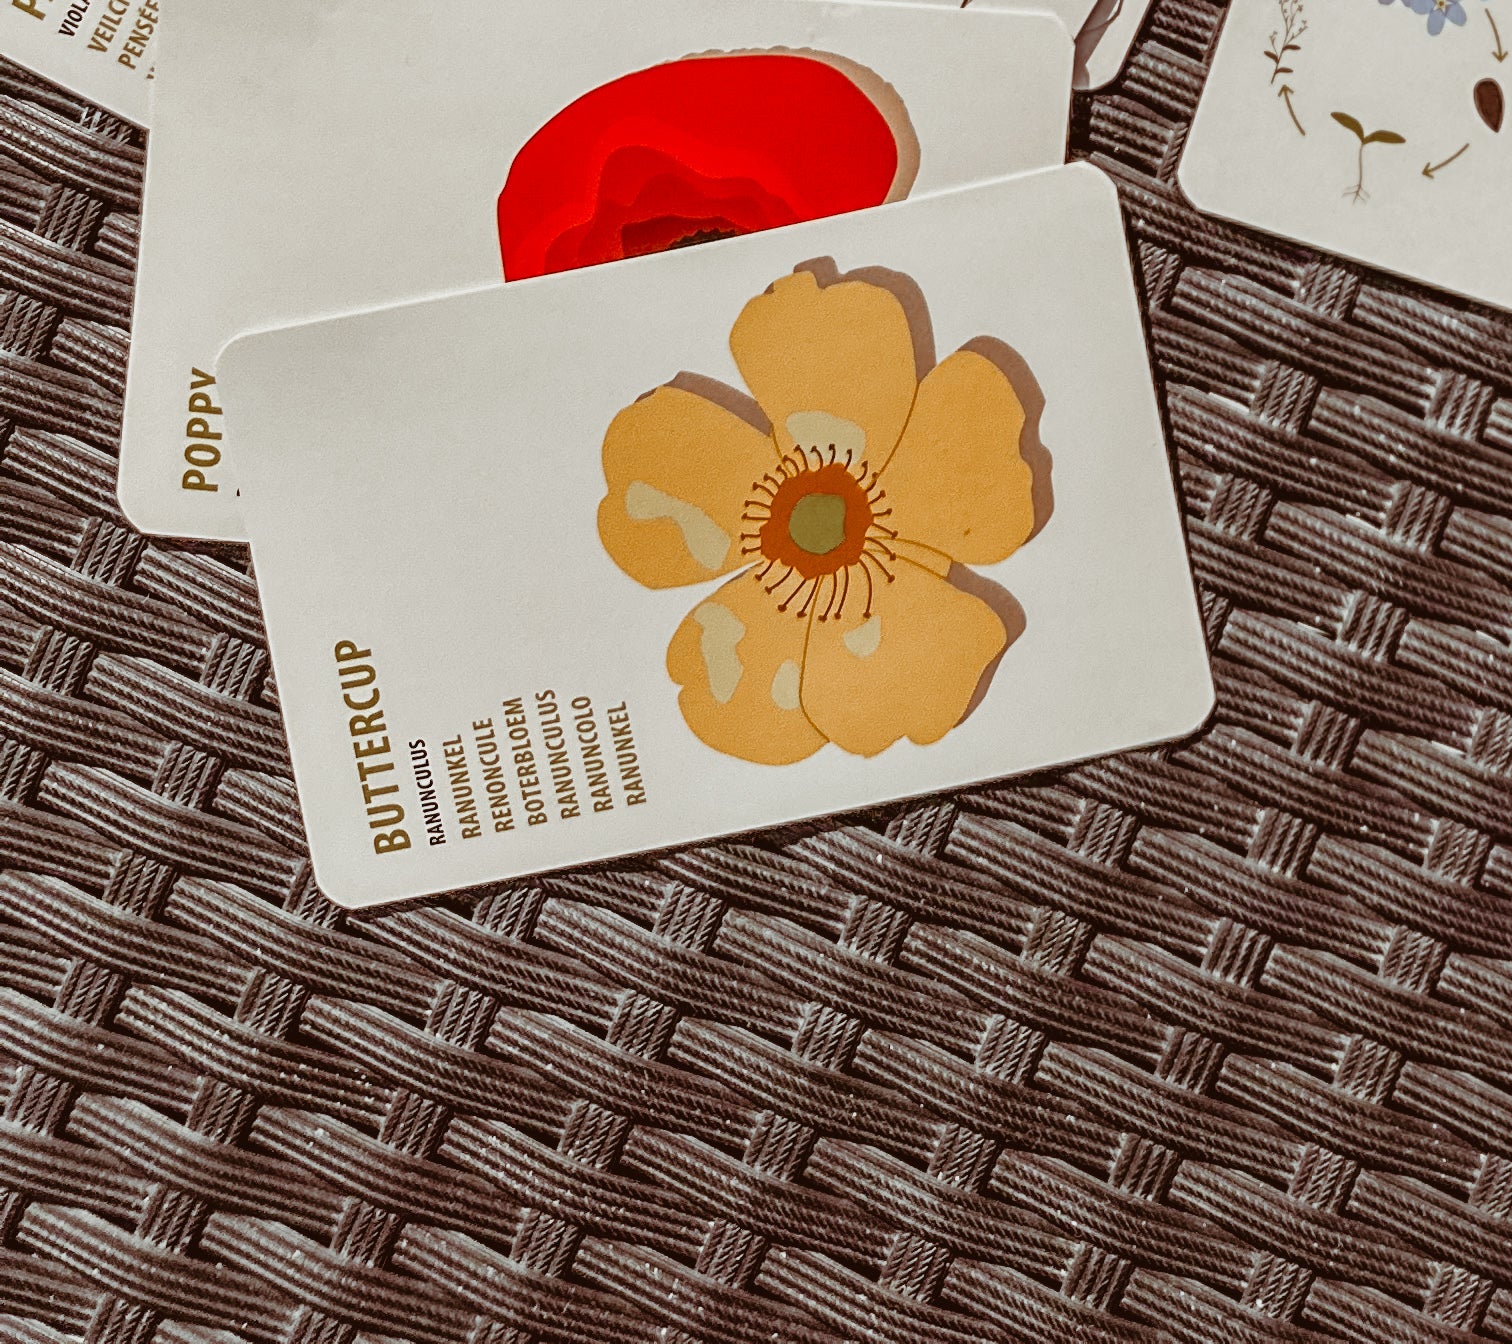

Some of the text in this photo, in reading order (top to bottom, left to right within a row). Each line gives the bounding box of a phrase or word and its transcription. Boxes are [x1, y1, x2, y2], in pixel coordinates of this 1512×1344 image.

[181, 367, 223, 492] POPPY
[335, 640, 411, 854] BUTTERCUP
[409, 739, 446, 846] RANUNCULUS
[443, 734, 482, 839] RANUNKEL
[472, 718, 515, 832] RENONCULE
[503, 697, 547, 826] BOTERBLOEM
[535, 690, 581, 819] RANUNCULUS
[571, 696, 614, 812] RANUNCOLO
[607, 701, 646, 806] RANUNKEL
